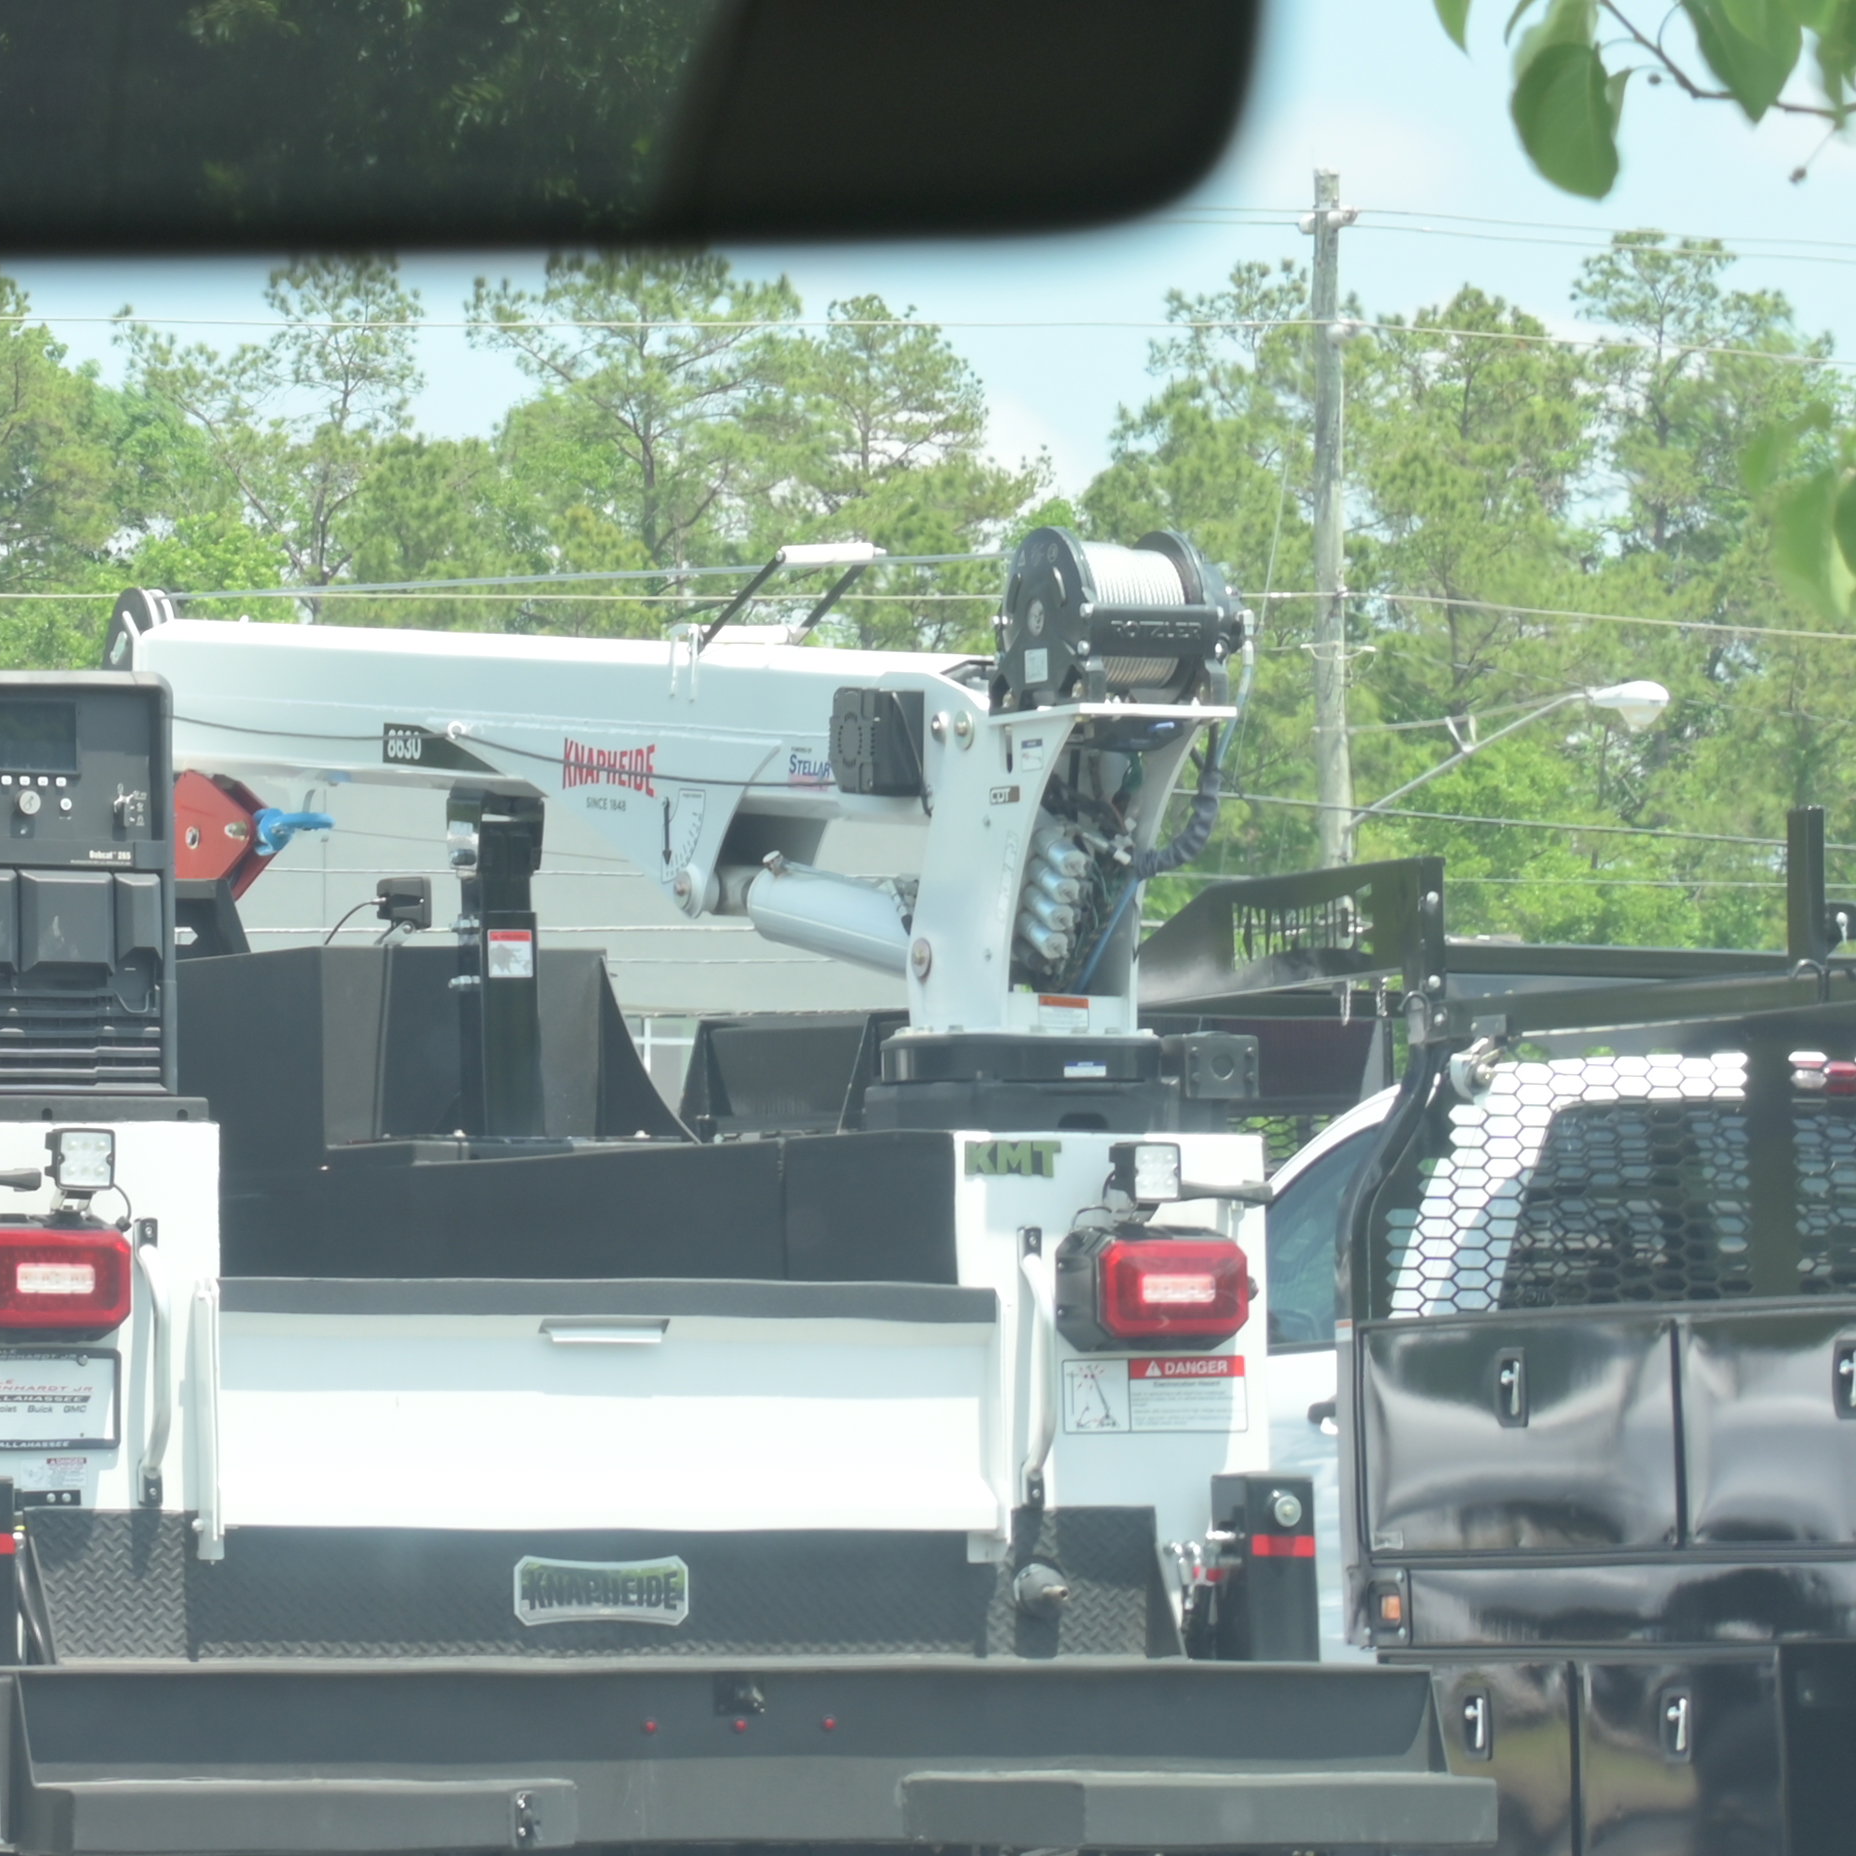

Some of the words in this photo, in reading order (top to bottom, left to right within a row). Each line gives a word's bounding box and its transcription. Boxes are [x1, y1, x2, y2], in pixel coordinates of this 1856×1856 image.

[562, 737, 656, 799] KNAPHEIDE
[586, 796, 607, 810] SINCE
[964, 1140, 1062, 1178] KMT
[1164, 1360, 1228, 1375] DANGER
[27, 1405, 53, 1413] Buick
[63, 1405, 87, 1413] GMC
[524, 1571, 678, 1611] KNAPHEIDE
